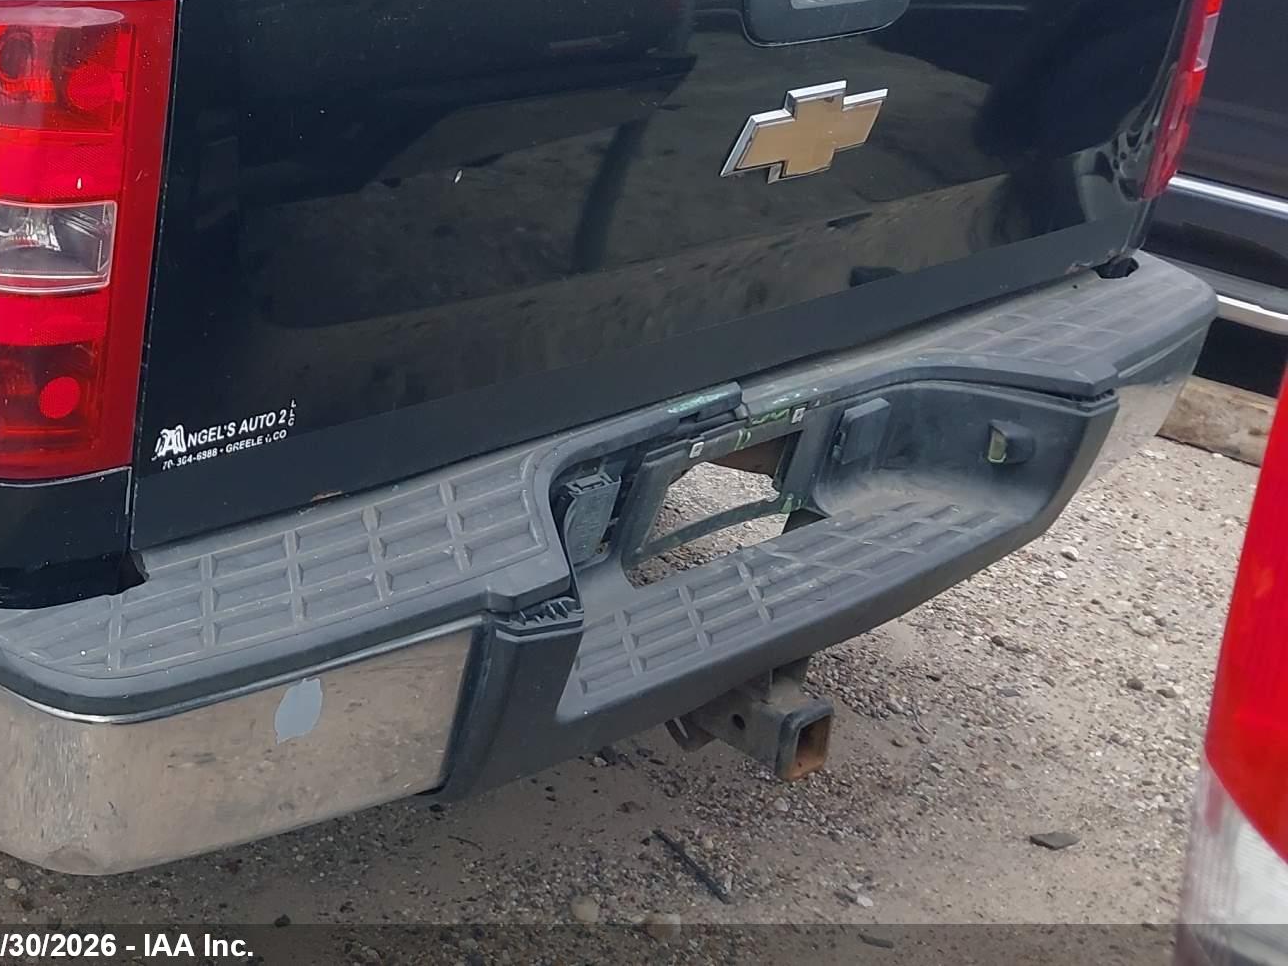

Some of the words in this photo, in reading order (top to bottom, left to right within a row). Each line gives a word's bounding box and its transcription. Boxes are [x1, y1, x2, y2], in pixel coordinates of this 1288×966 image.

[238, 412, 276, 435] AUTO
[278, 409, 287, 424] 2
[273, 429, 287, 441] CO
